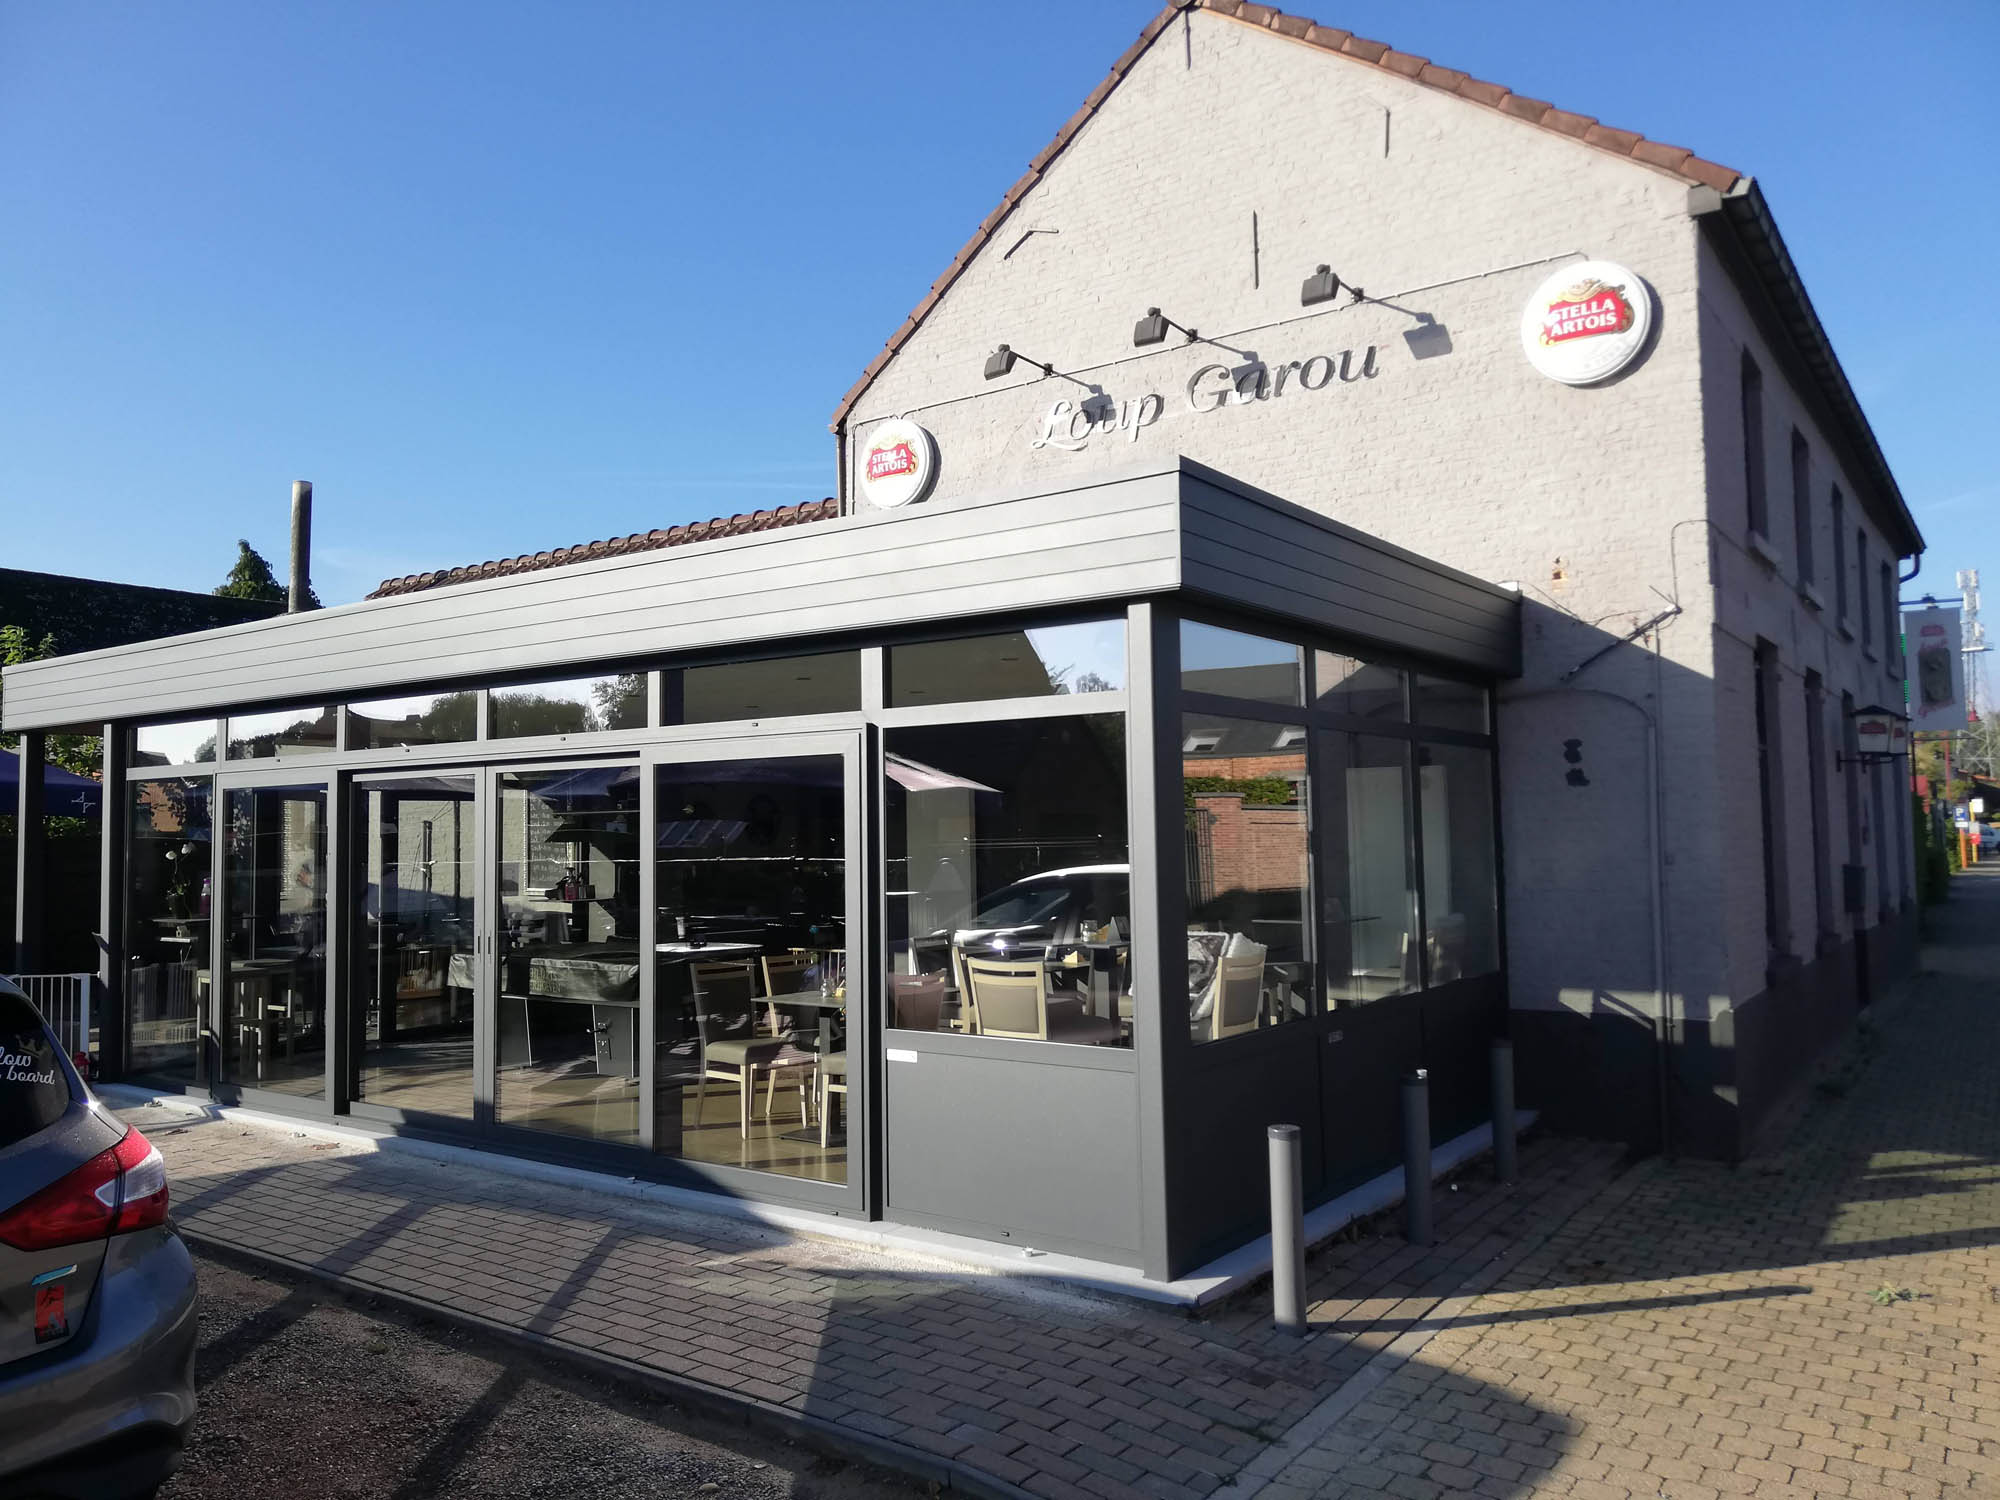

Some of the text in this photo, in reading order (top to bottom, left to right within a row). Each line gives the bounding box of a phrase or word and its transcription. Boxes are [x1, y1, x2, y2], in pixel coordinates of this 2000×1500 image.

[1551, 312, 1617, 337] ARTOIS
[1031, 345, 1380, 452] Loup Garou
[872, 459, 908, 475] ARTOIS
[6, 1065, 56, 1085] board
